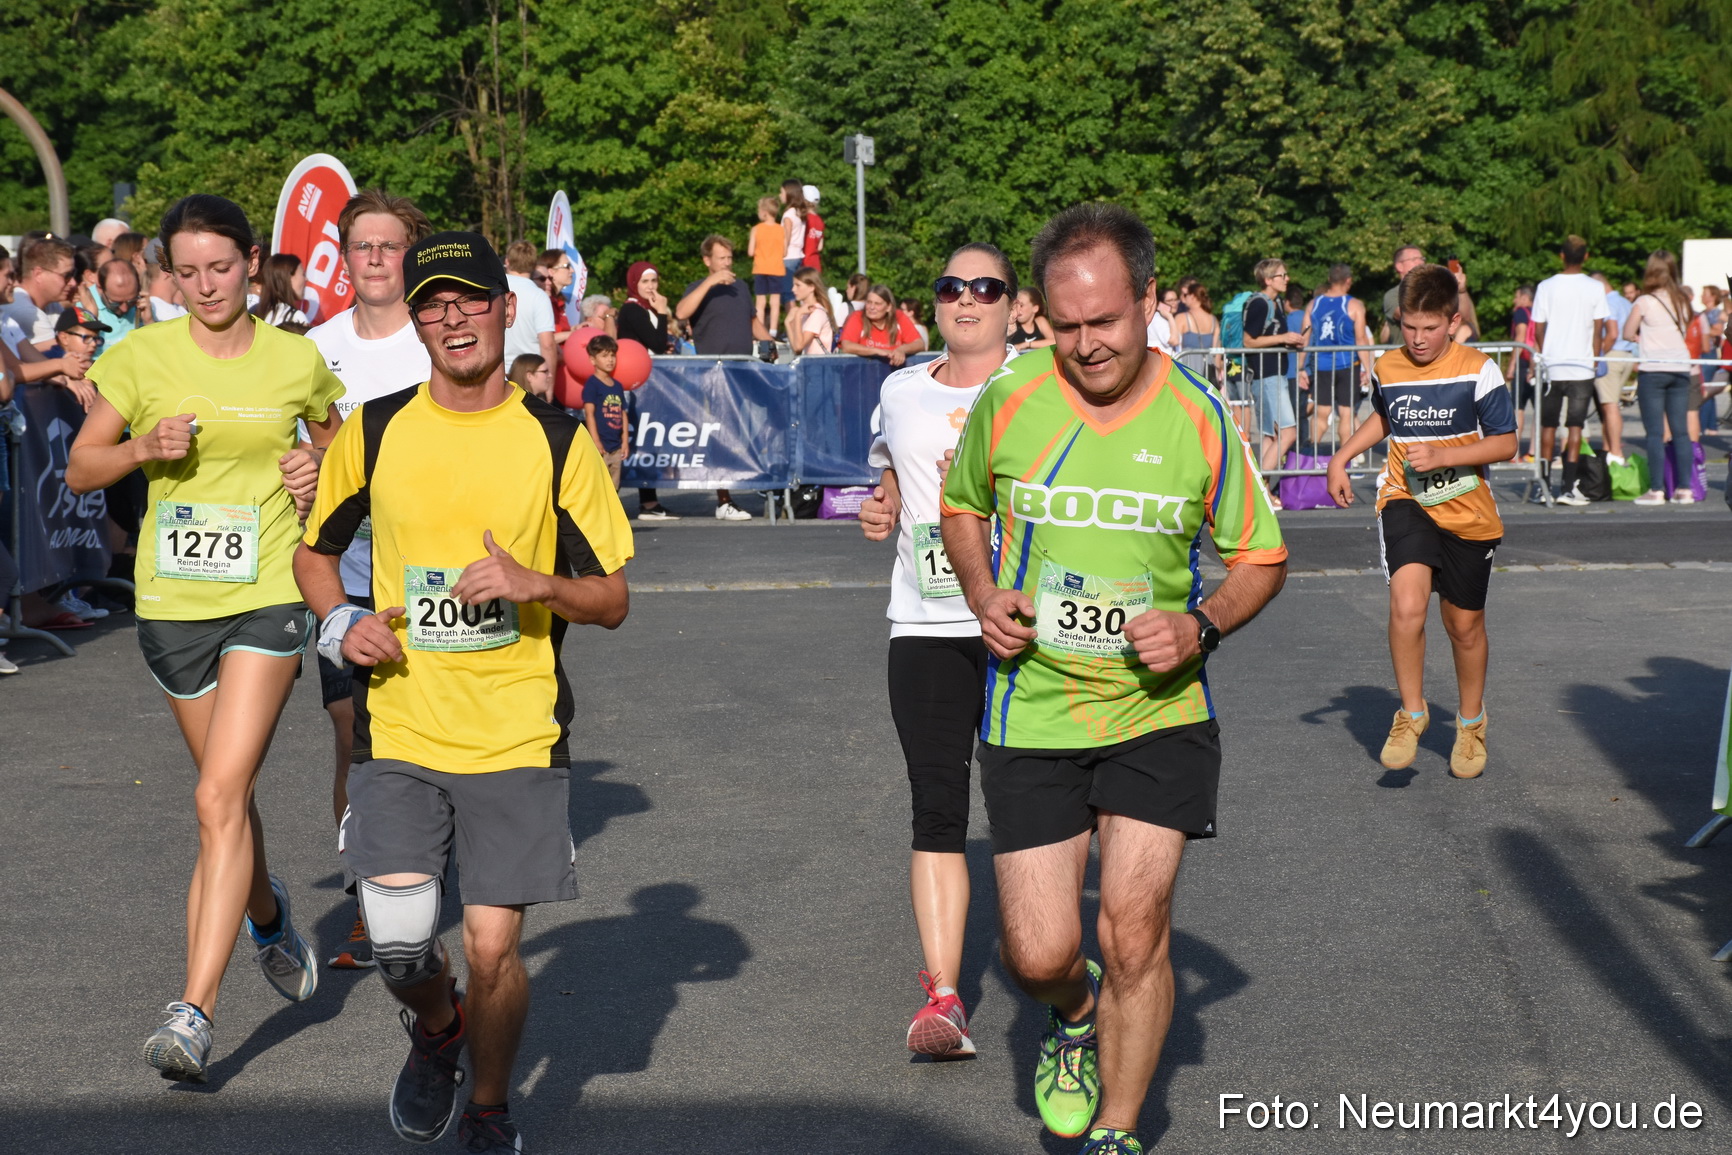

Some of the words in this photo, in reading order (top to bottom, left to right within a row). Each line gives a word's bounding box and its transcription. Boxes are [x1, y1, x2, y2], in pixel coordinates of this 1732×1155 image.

[297, 182, 316, 217] AVIA
[417, 243, 470, 258] Schwimmfest
[417, 249, 472, 266] Holnstein
[1397, 405, 1457, 420] Fischer
[1417, 467, 1460, 493] 782
[1010, 479, 1189, 535] BOCK
[168, 515, 208, 526] firmenlauf
[232, 525, 252, 533] 2019
[167, 529, 243, 560] 1278
[177, 559, 201, 567] Reindl
[203, 560, 231, 569] Regina
[928, 577, 959, 585] Osterma
[1054, 581, 1101, 600] firmenlauf
[1126, 597, 1147, 606] 2019
[417, 597, 505, 628] 2004
[1057, 600, 1126, 635] 330
[421, 628, 458, 638] Bergrath
[460, 623, 505, 636] Alexander
[1057, 630, 1086, 642] Seidel
[1088, 635, 1123, 644] Markus
[1053, 637, 1069, 646] Bock
[1075, 641, 1095, 649] GmbH
